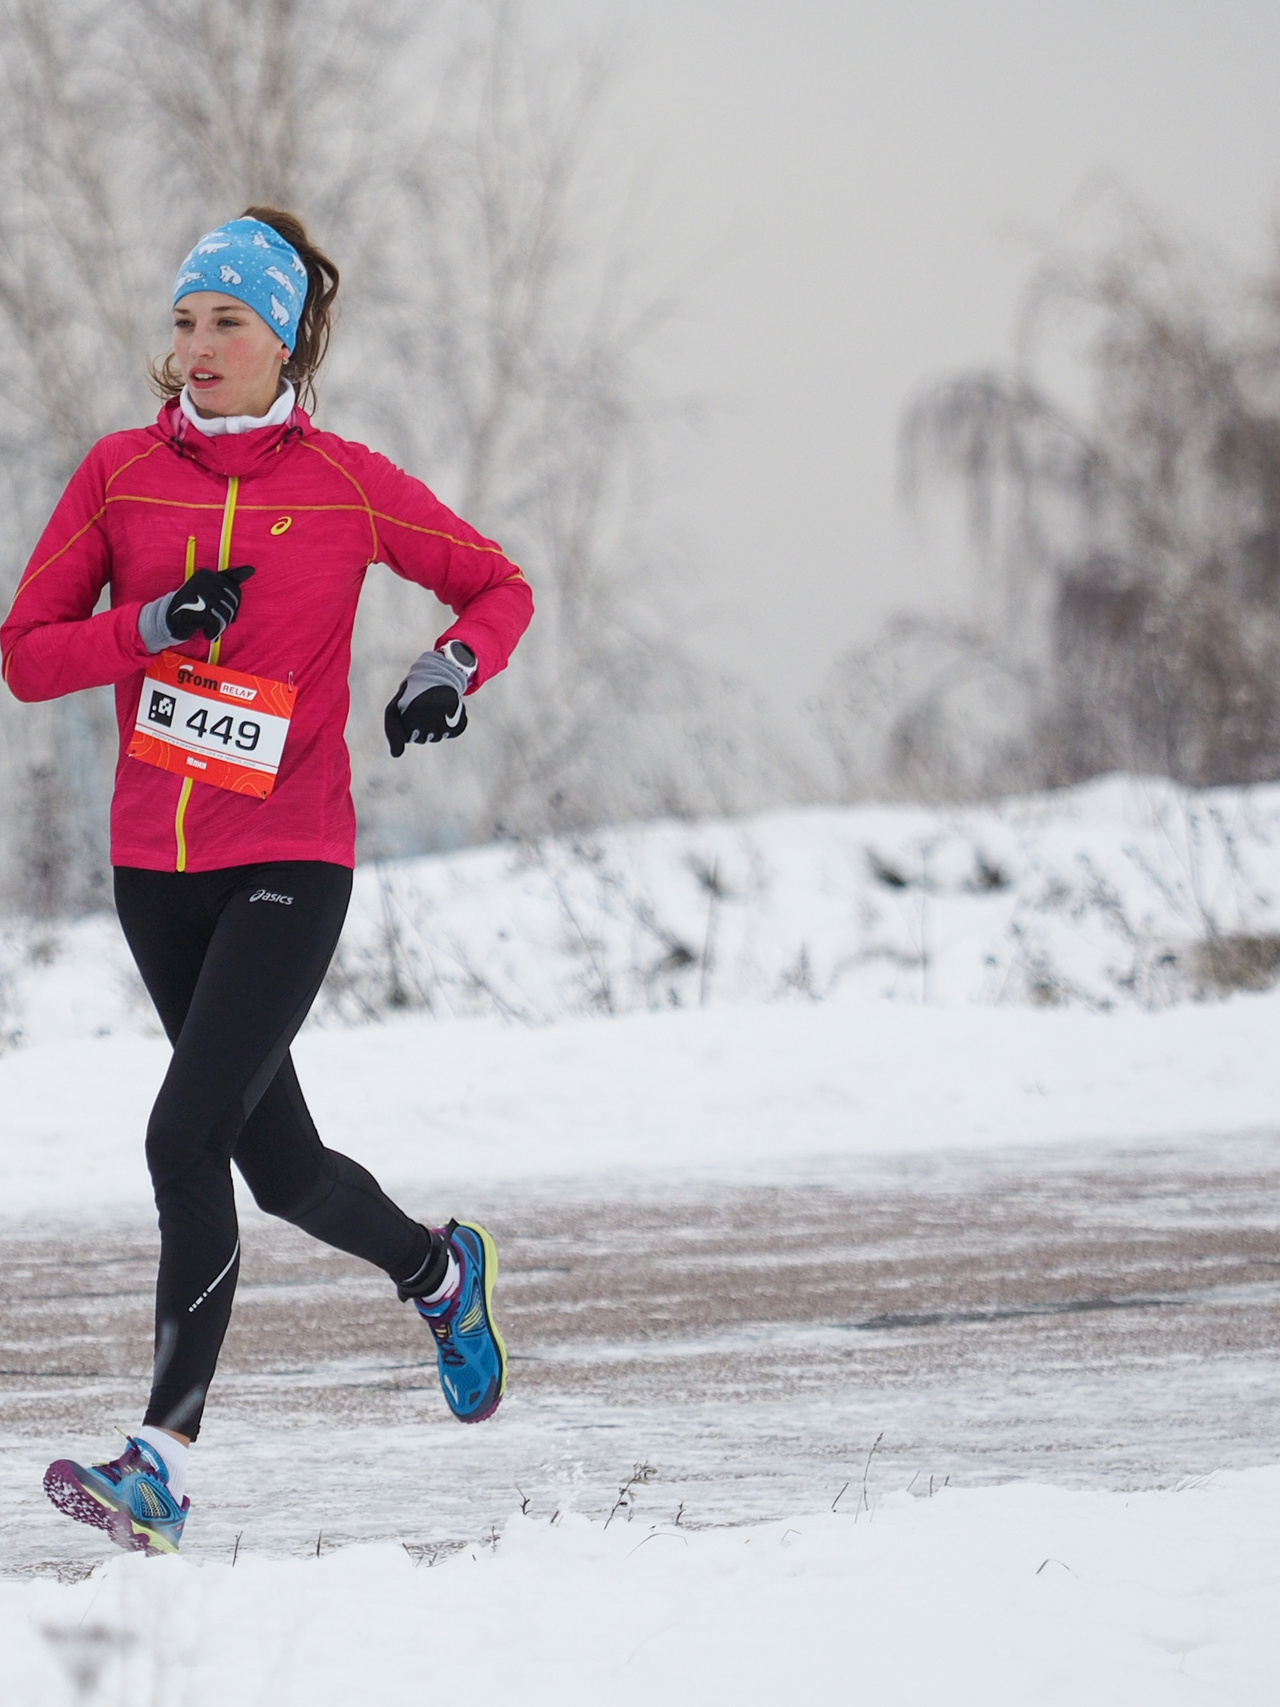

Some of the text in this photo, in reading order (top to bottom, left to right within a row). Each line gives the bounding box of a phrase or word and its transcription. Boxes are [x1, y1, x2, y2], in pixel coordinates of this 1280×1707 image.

[177, 668, 255, 699] grom RELAY
[186, 708, 261, 752] 449
